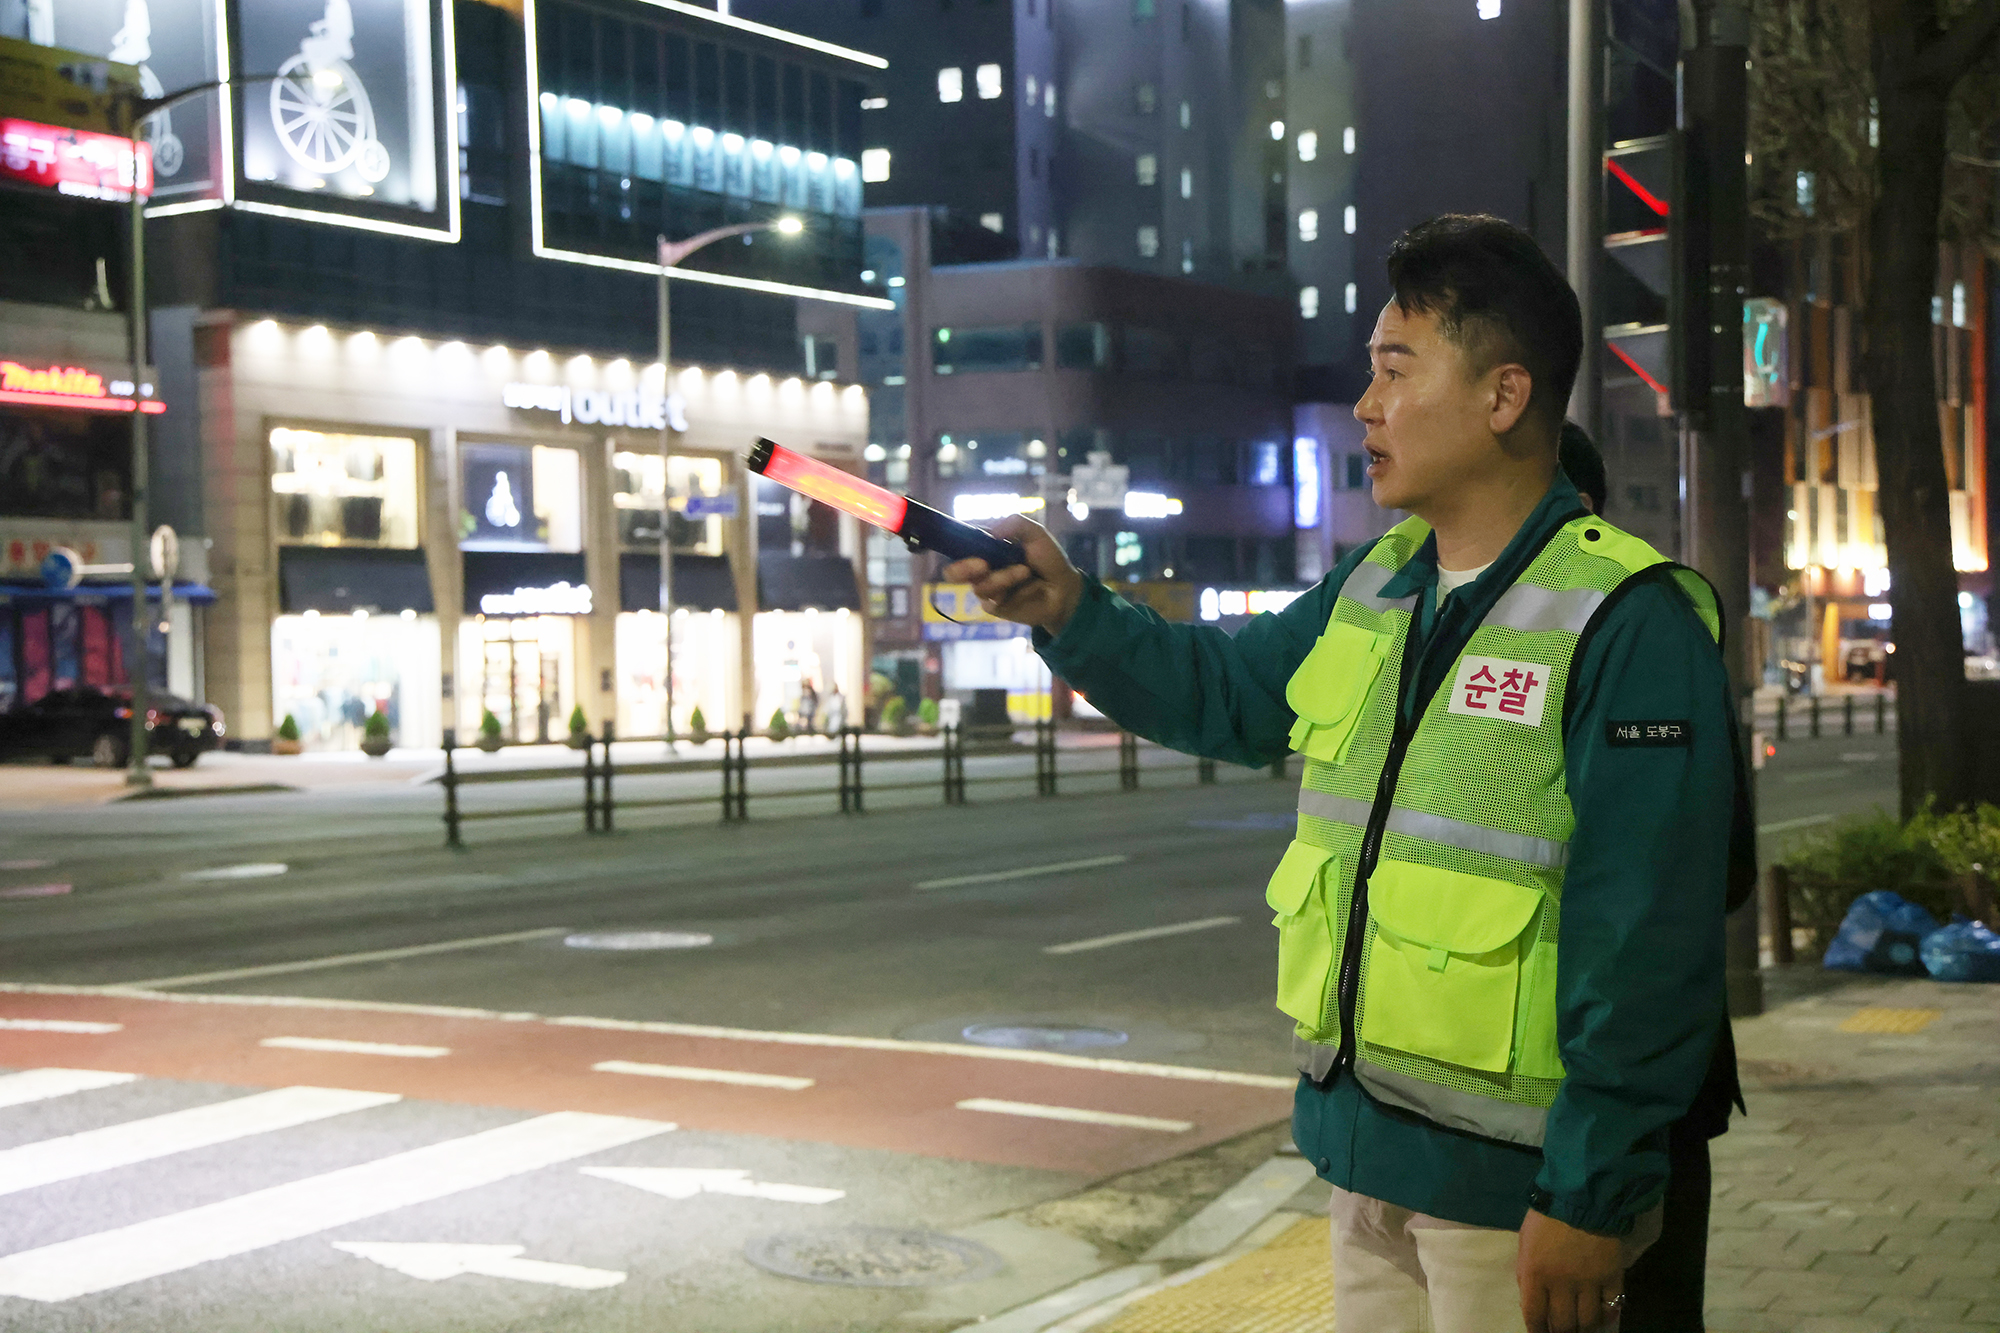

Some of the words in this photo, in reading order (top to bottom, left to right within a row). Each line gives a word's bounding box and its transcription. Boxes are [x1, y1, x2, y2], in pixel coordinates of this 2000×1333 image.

[1464, 664, 1539, 716] 순찰
[1616, 725, 1641, 739] 서울
[1646, 725, 1682, 738] 도봉구
